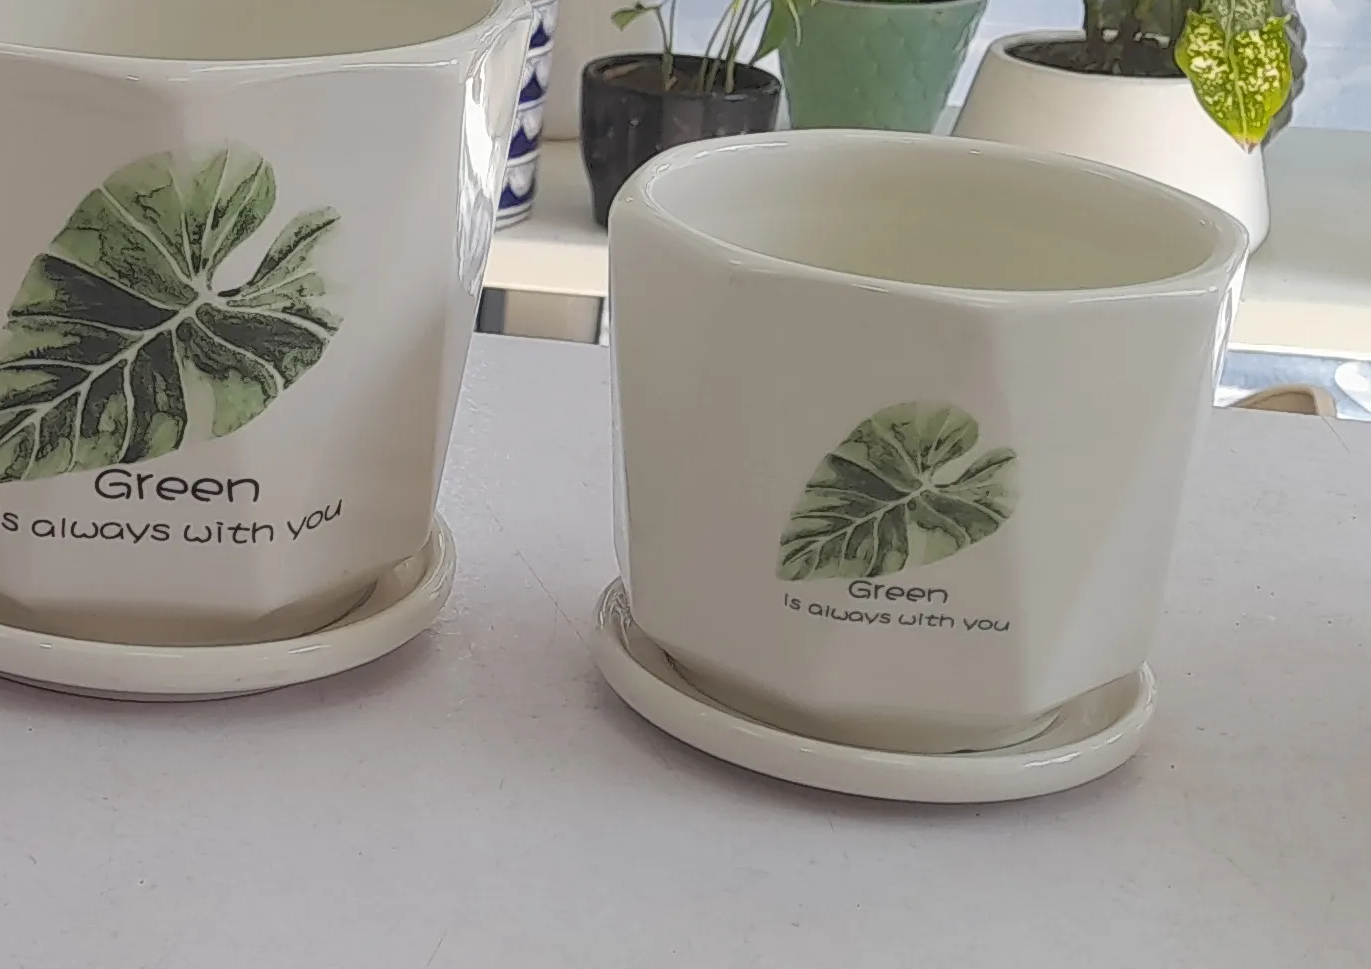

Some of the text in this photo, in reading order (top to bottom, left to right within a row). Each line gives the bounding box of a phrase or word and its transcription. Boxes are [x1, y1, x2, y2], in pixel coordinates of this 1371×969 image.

[94, 468, 260, 503] Green
[31, 518, 170, 544] always
[183, 521, 274, 544] with
[287, 499, 343, 541] you
[848, 580, 949, 604] Green
[808, 602, 891, 625] always
[898, 612, 955, 628] with
[963, 617, 1010, 632] you
